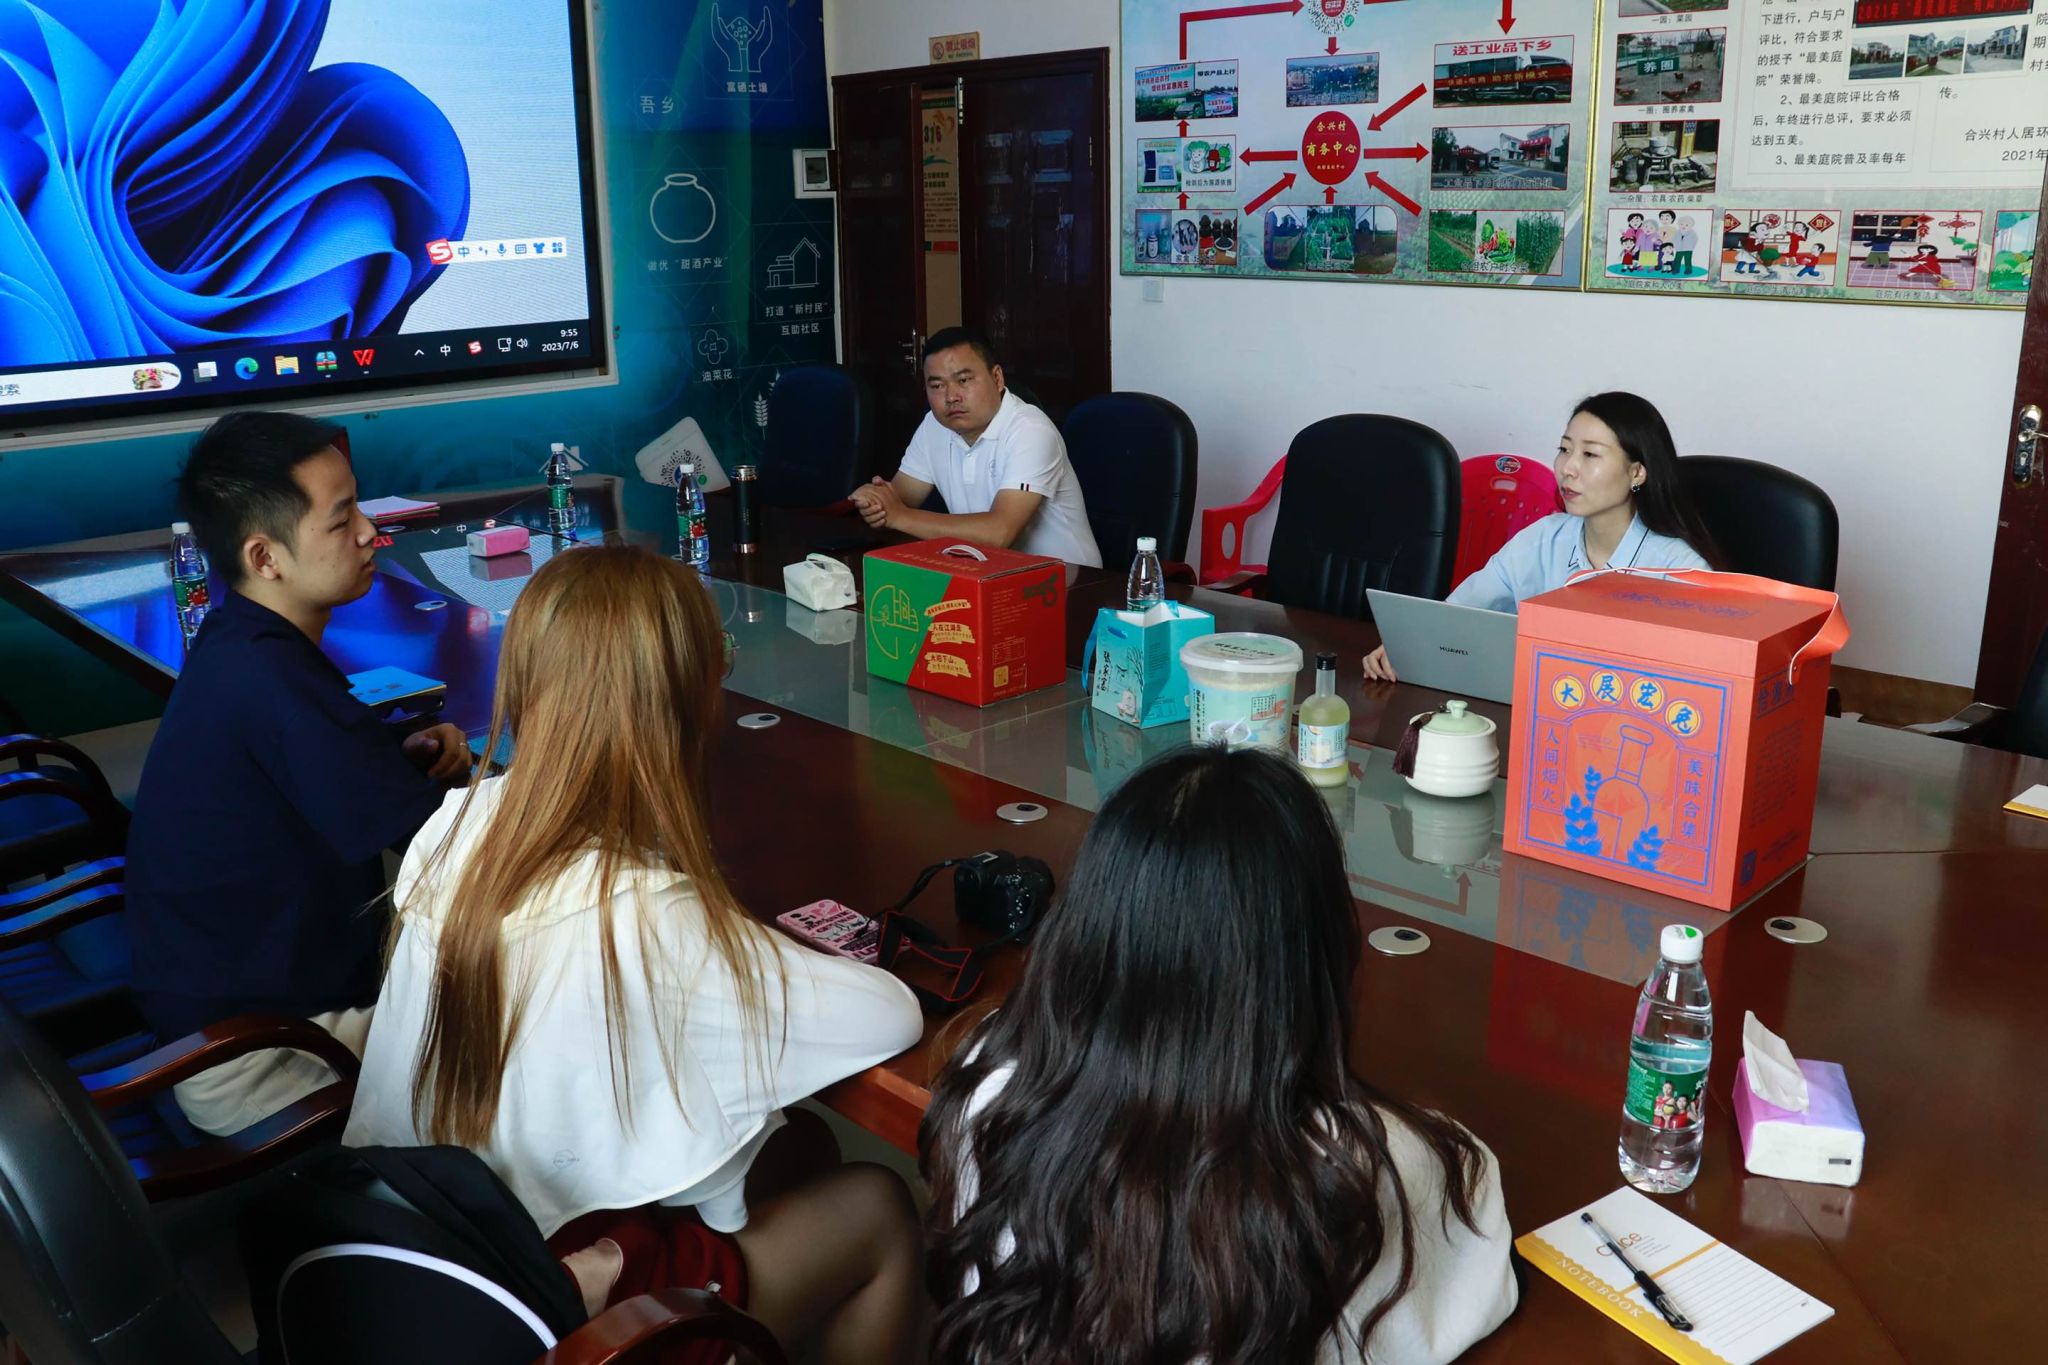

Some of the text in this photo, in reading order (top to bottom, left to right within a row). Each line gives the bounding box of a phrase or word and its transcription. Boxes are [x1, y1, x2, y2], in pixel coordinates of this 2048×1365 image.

[1452, 39, 1552, 57] 送工业品下乡
[640, 95, 674, 114] 吾乡
[1316, 120, 1347, 132] 合兴村
[1306, 141, 1358, 158] 商务中心
[458, 246, 470, 258] 中
[560, 328, 578, 337] 9:55
[781, 323, 820, 336] 互助社区
[440, 344, 451, 356] 中
[542, 341, 579, 352] 2023/7/6
[702, 368, 734, 382] 油菜花
[1439, 646, 1469, 656] HUAWEI
[1543, 727, 1559, 804] 人间烟火
[1557, 1259, 1643, 1319] NOTEBOOK
